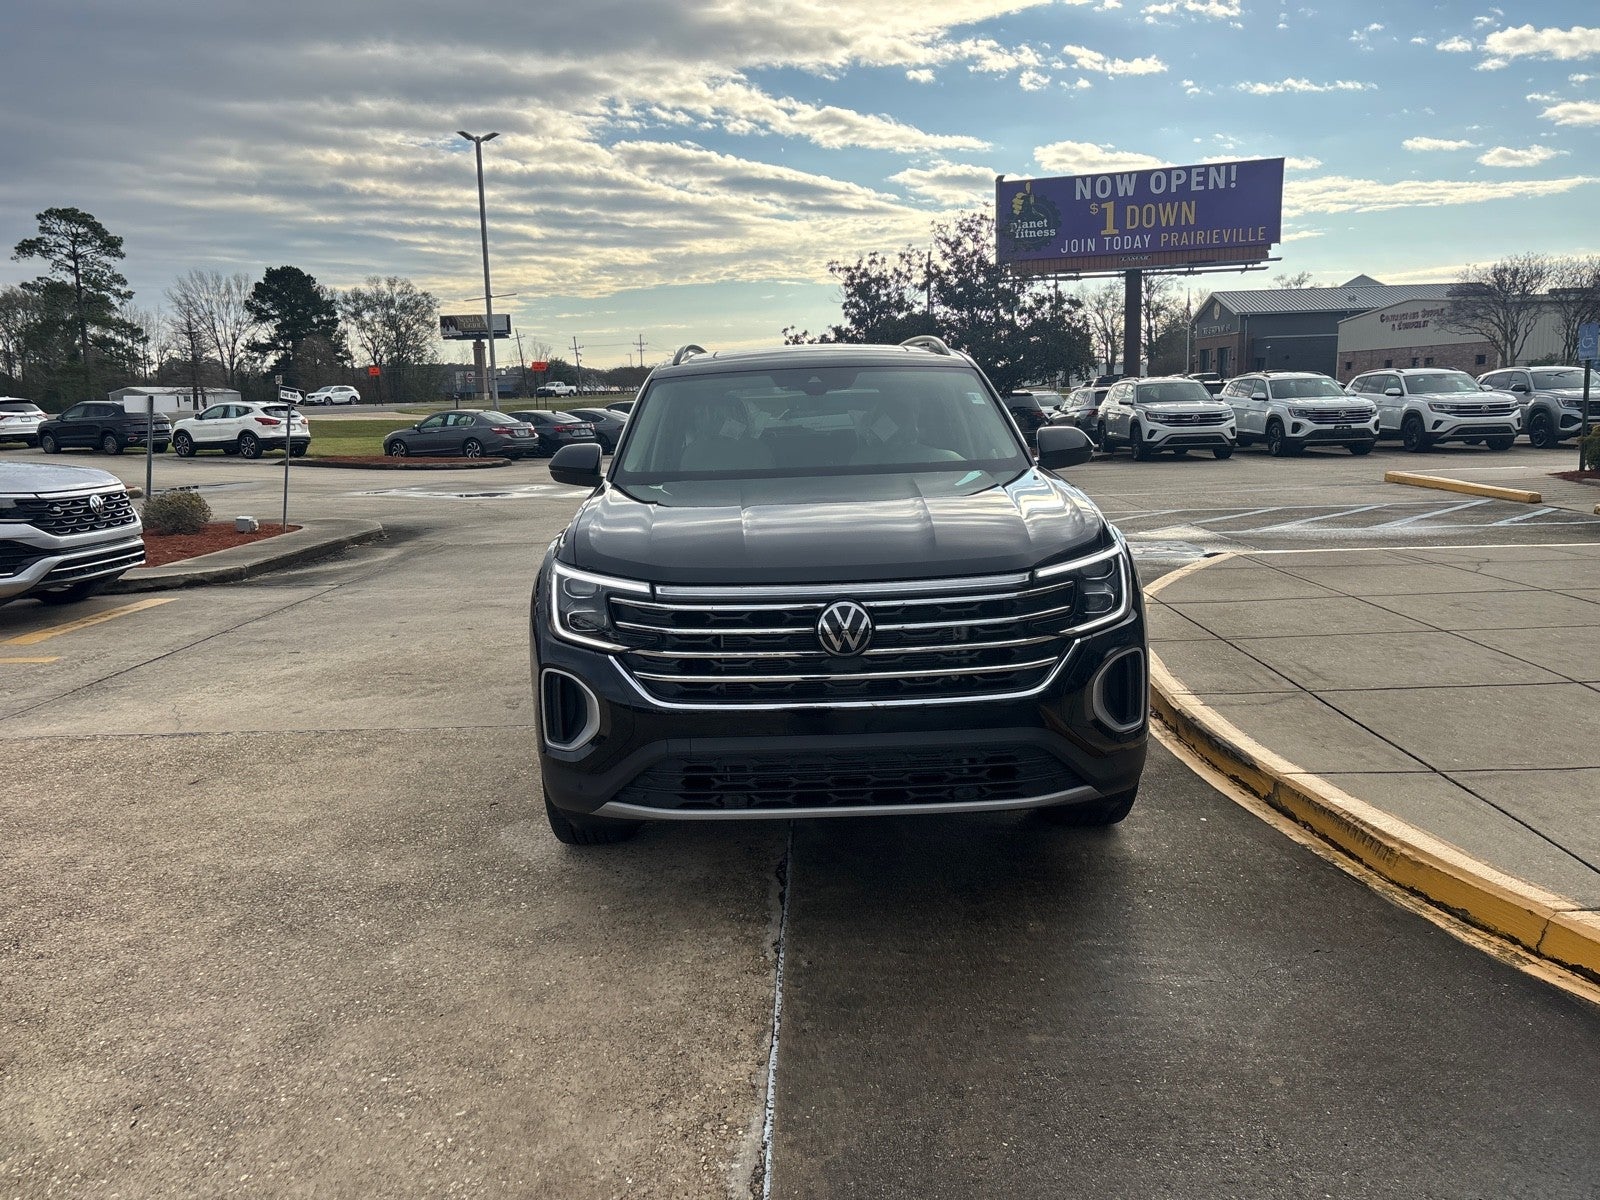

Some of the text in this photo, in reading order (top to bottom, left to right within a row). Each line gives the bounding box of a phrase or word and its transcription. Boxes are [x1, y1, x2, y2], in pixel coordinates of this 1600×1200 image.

[1075, 165, 1237, 200] NOW OPEN!
[1126, 200, 1196, 230] DOWN
[1015, 228, 1056, 238] fitness
[1060, 226, 1266, 254] JOIN TODAY PRAIRIEVILLE
